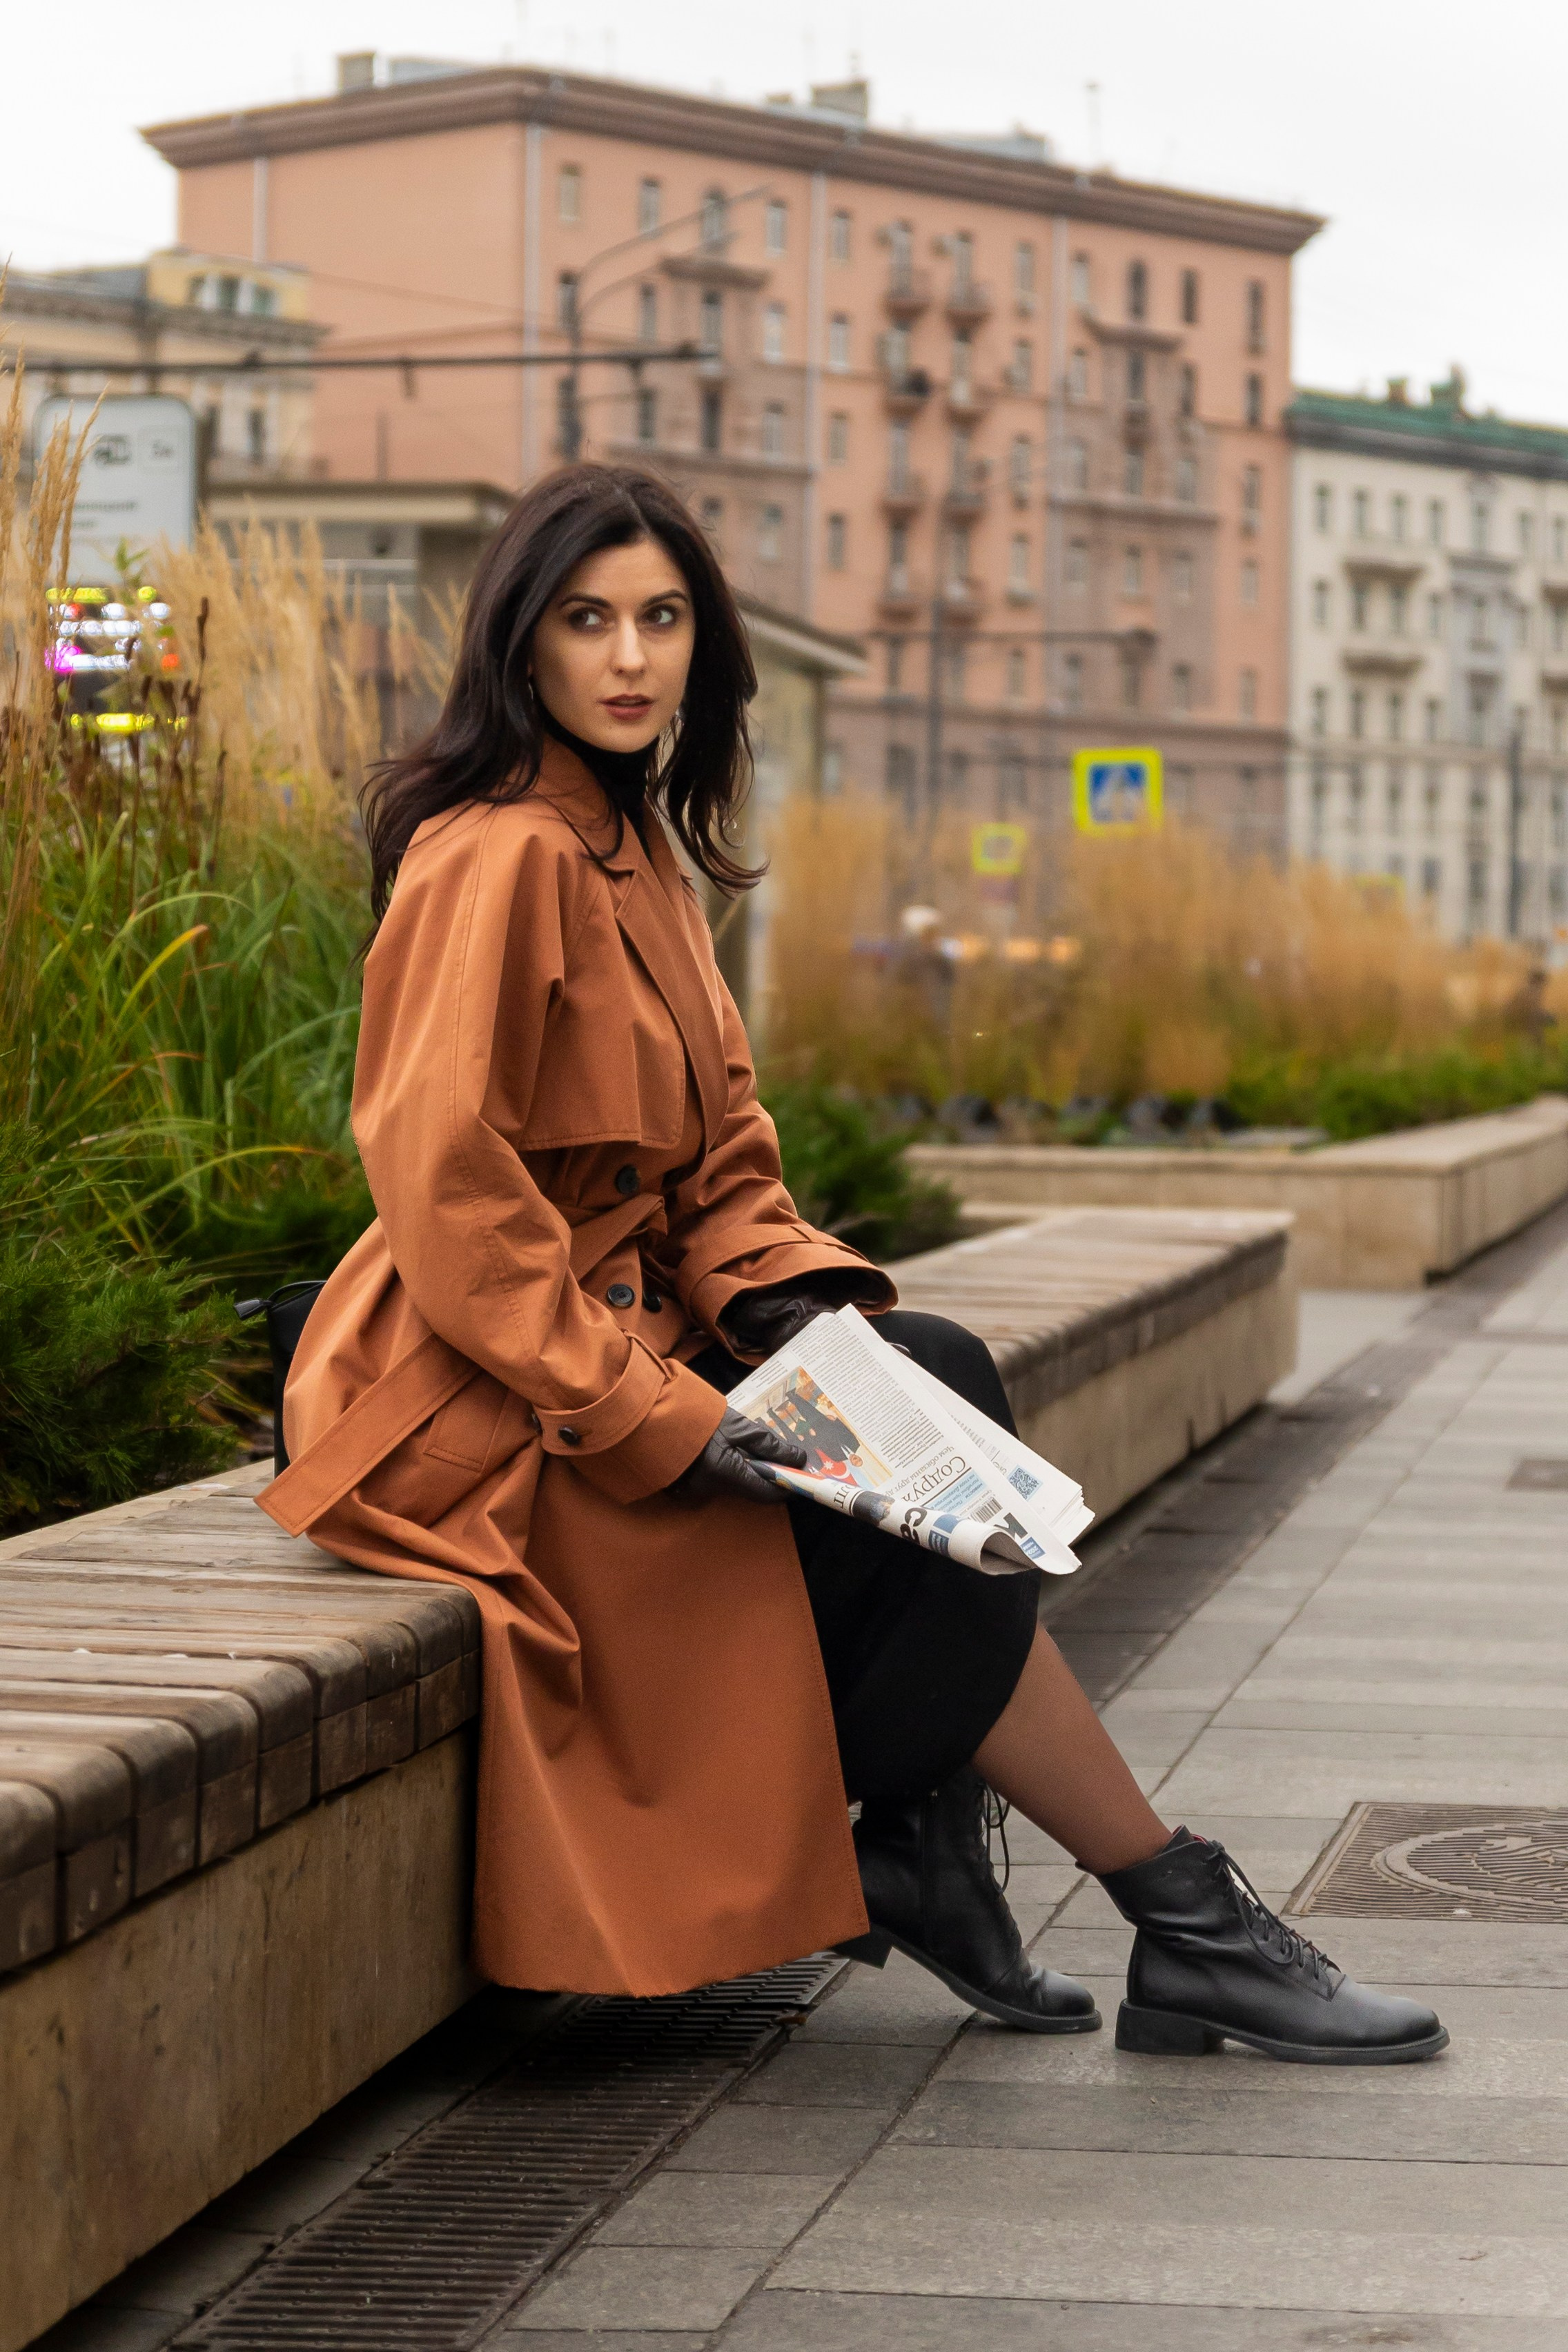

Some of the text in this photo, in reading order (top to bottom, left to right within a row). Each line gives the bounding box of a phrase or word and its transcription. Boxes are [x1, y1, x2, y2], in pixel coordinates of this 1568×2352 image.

[883, 1446, 954, 1499] Чем обязаны друг др
